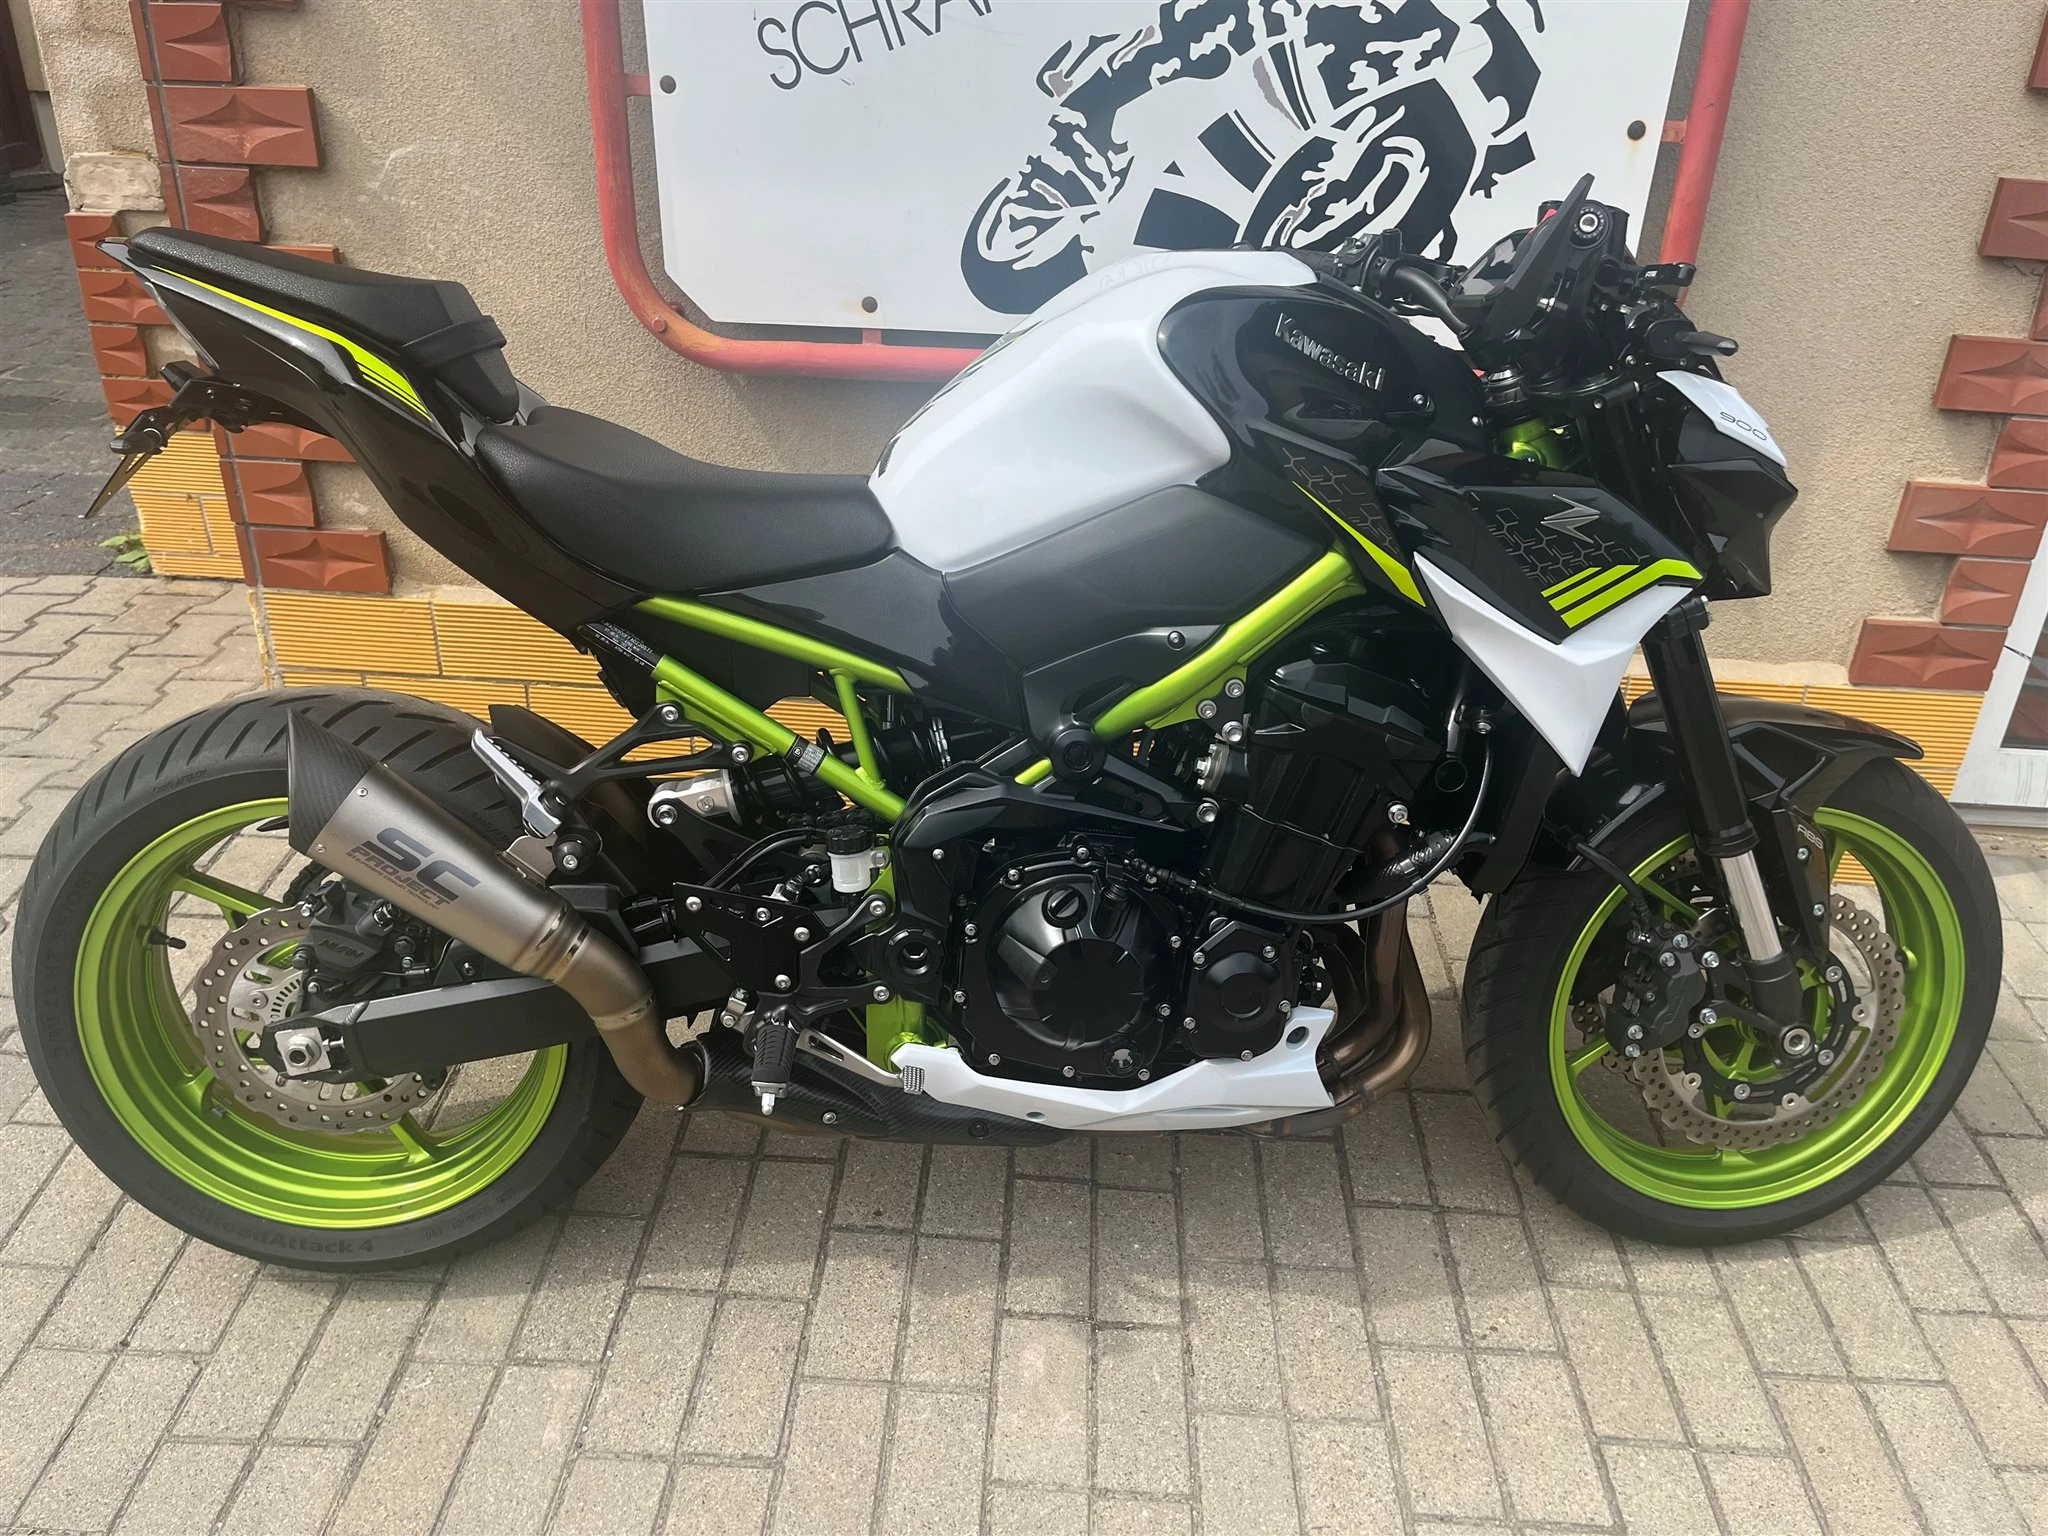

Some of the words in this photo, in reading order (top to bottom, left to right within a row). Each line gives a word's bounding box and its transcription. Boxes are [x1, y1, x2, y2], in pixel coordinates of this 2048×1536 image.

[1275, 312, 1387, 392] Kawasaki
[1719, 411, 1768, 441] 900
[361, 827, 481, 902] SC
[1796, 823, 1824, 850] ABS
[350, 845, 451, 906] PROJECT
